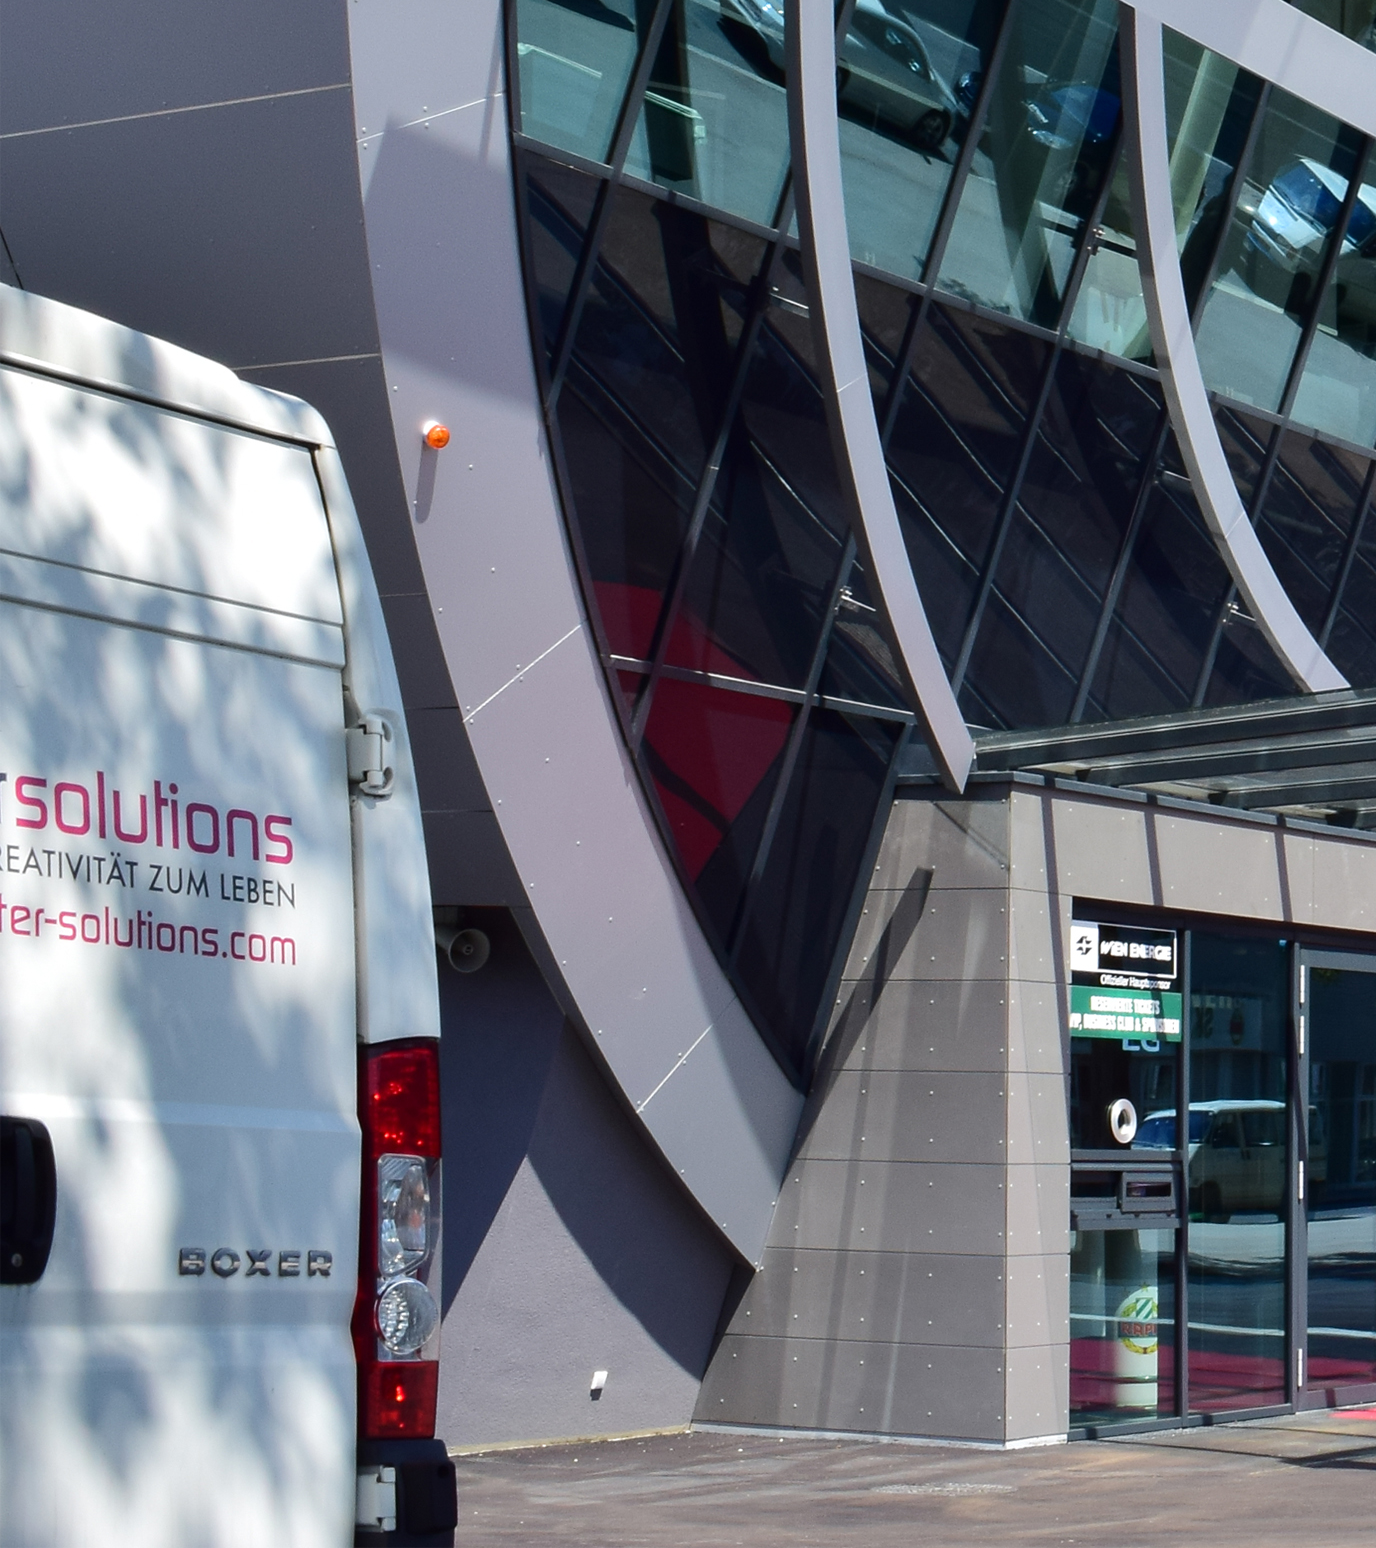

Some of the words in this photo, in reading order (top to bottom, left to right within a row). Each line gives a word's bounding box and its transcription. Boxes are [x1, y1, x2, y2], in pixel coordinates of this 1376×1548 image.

[0, 845, 138, 888] EATIVITÄT
[148, 864, 209, 898] ZUM
[221, 873, 296, 909] LEBEN
[1100, 940, 1128, 957] WIEN
[1129, 942, 1172, 961] ENERGIE
[179, 1247, 333, 1278] BOXER
